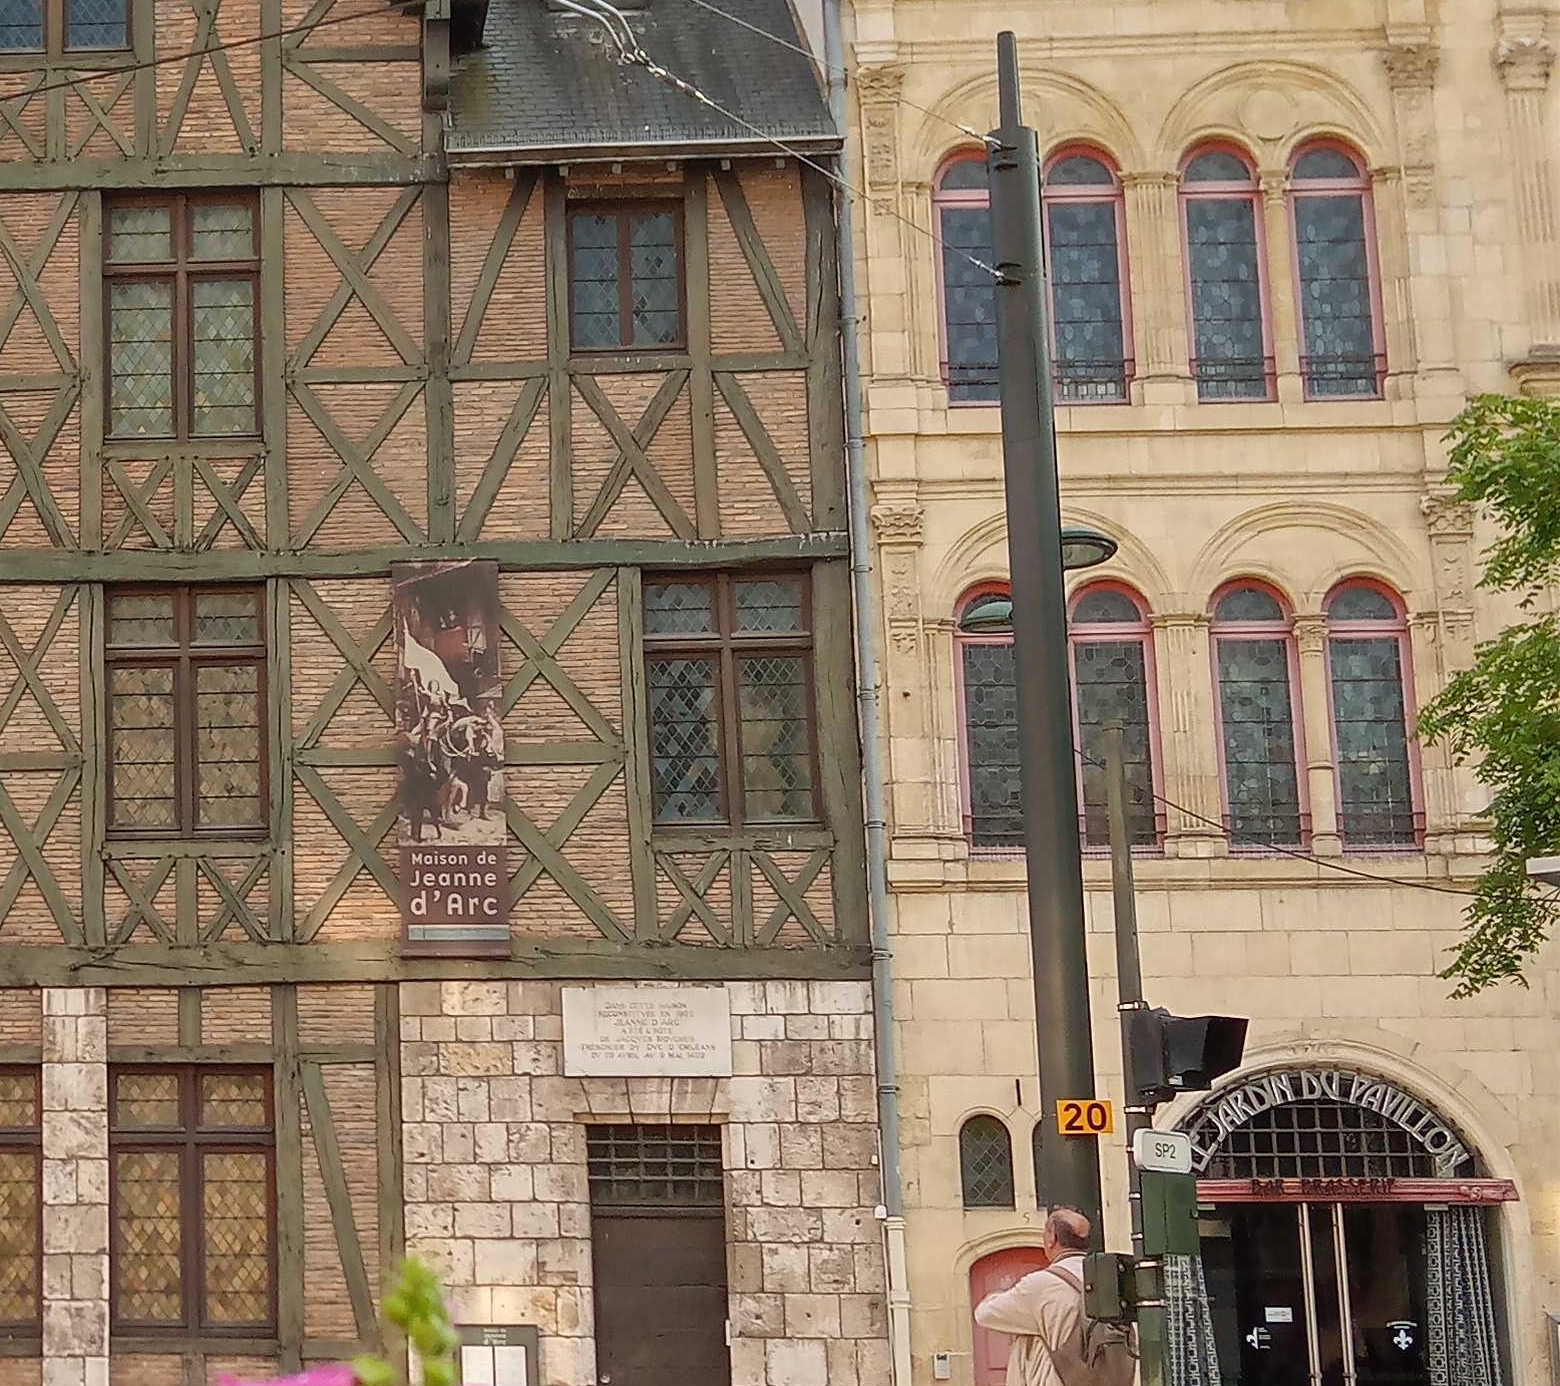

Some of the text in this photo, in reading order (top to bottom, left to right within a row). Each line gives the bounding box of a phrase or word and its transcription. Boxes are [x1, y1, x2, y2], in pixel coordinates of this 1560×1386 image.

[411, 850, 497, 865] Maison de
[409, 870, 497, 887] Jeanne
[1063, 1103, 1108, 1131] 20
[1207, 1073, 1296, 1143] JARDIN
[1300, 1070, 1342, 1101] DU
[1348, 1074, 1471, 1178] PAVILLON
[1154, 1142, 1177, 1160] SP2
[1251, 1178, 1396, 1196] BAR BRASSERIE
[1022, 1211, 1030, 1225] 5
